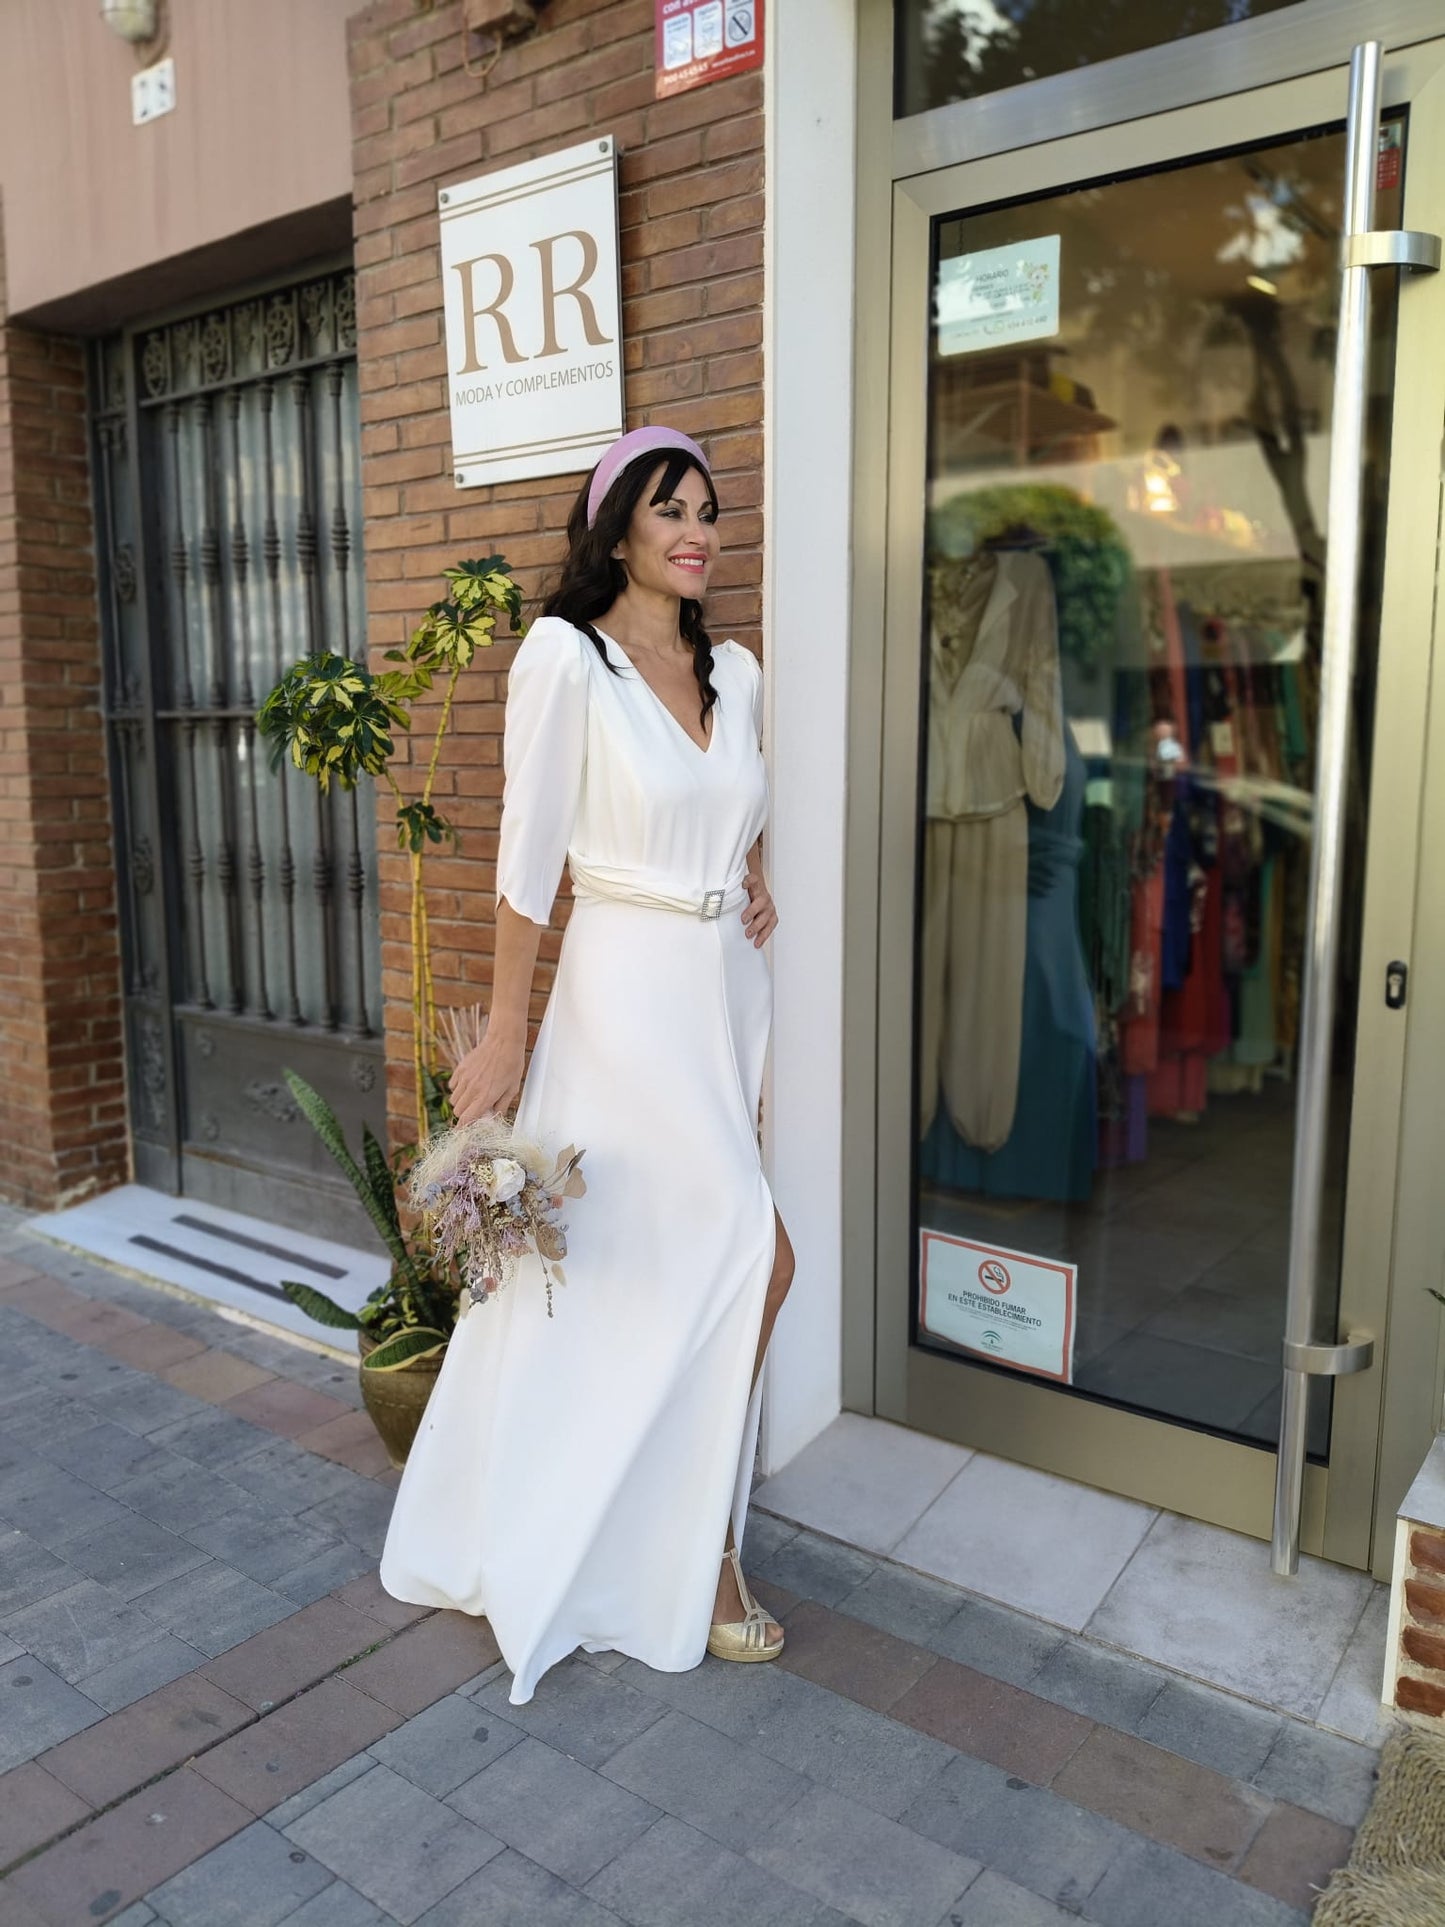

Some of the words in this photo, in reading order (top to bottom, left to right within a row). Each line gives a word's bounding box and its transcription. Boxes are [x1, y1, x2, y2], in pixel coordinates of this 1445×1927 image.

[451, 230, 614, 375] RR
[456, 386, 494, 406] MODA
[495, 383, 503, 399] Y
[506, 361, 614, 397] COMPLEMENTOS
[948, 1293, 958, 1302] EN
[960, 1297, 976, 1307] ESTE
[978, 1302, 1042, 1327] ESTABLECIMIENTO
[963, 1290, 1000, 1307] PROHIBIDO
[1002, 1302, 1027, 1315] FUMAR
